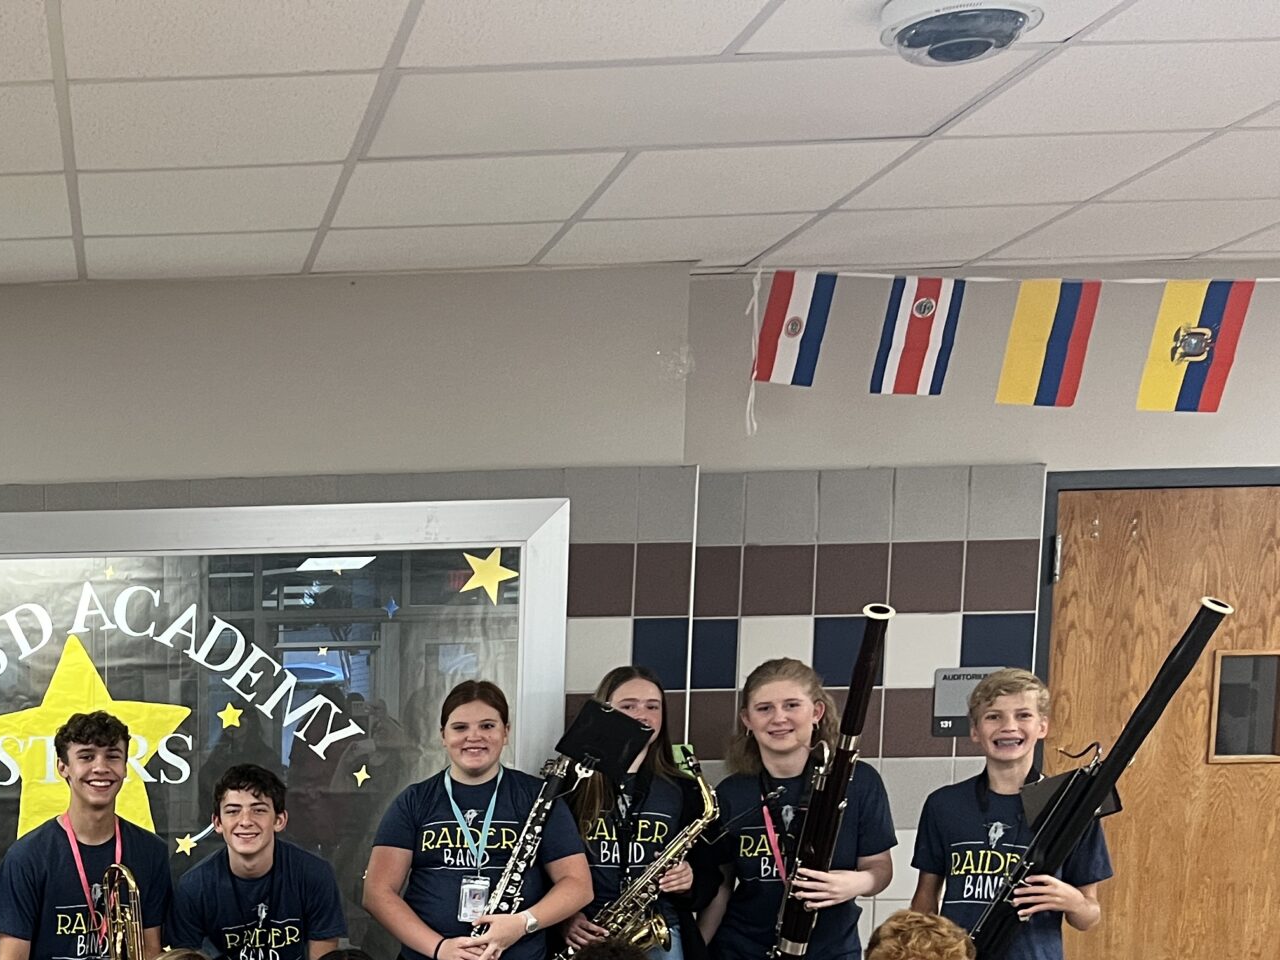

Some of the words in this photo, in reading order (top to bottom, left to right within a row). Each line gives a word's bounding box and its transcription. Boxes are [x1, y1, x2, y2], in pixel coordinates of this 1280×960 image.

[66, 581, 366, 760] ACADEMY
[940, 720, 952, 728] 131
[422, 827, 517, 851] RAIDER
[951, 850, 1021, 876] RAIDE
